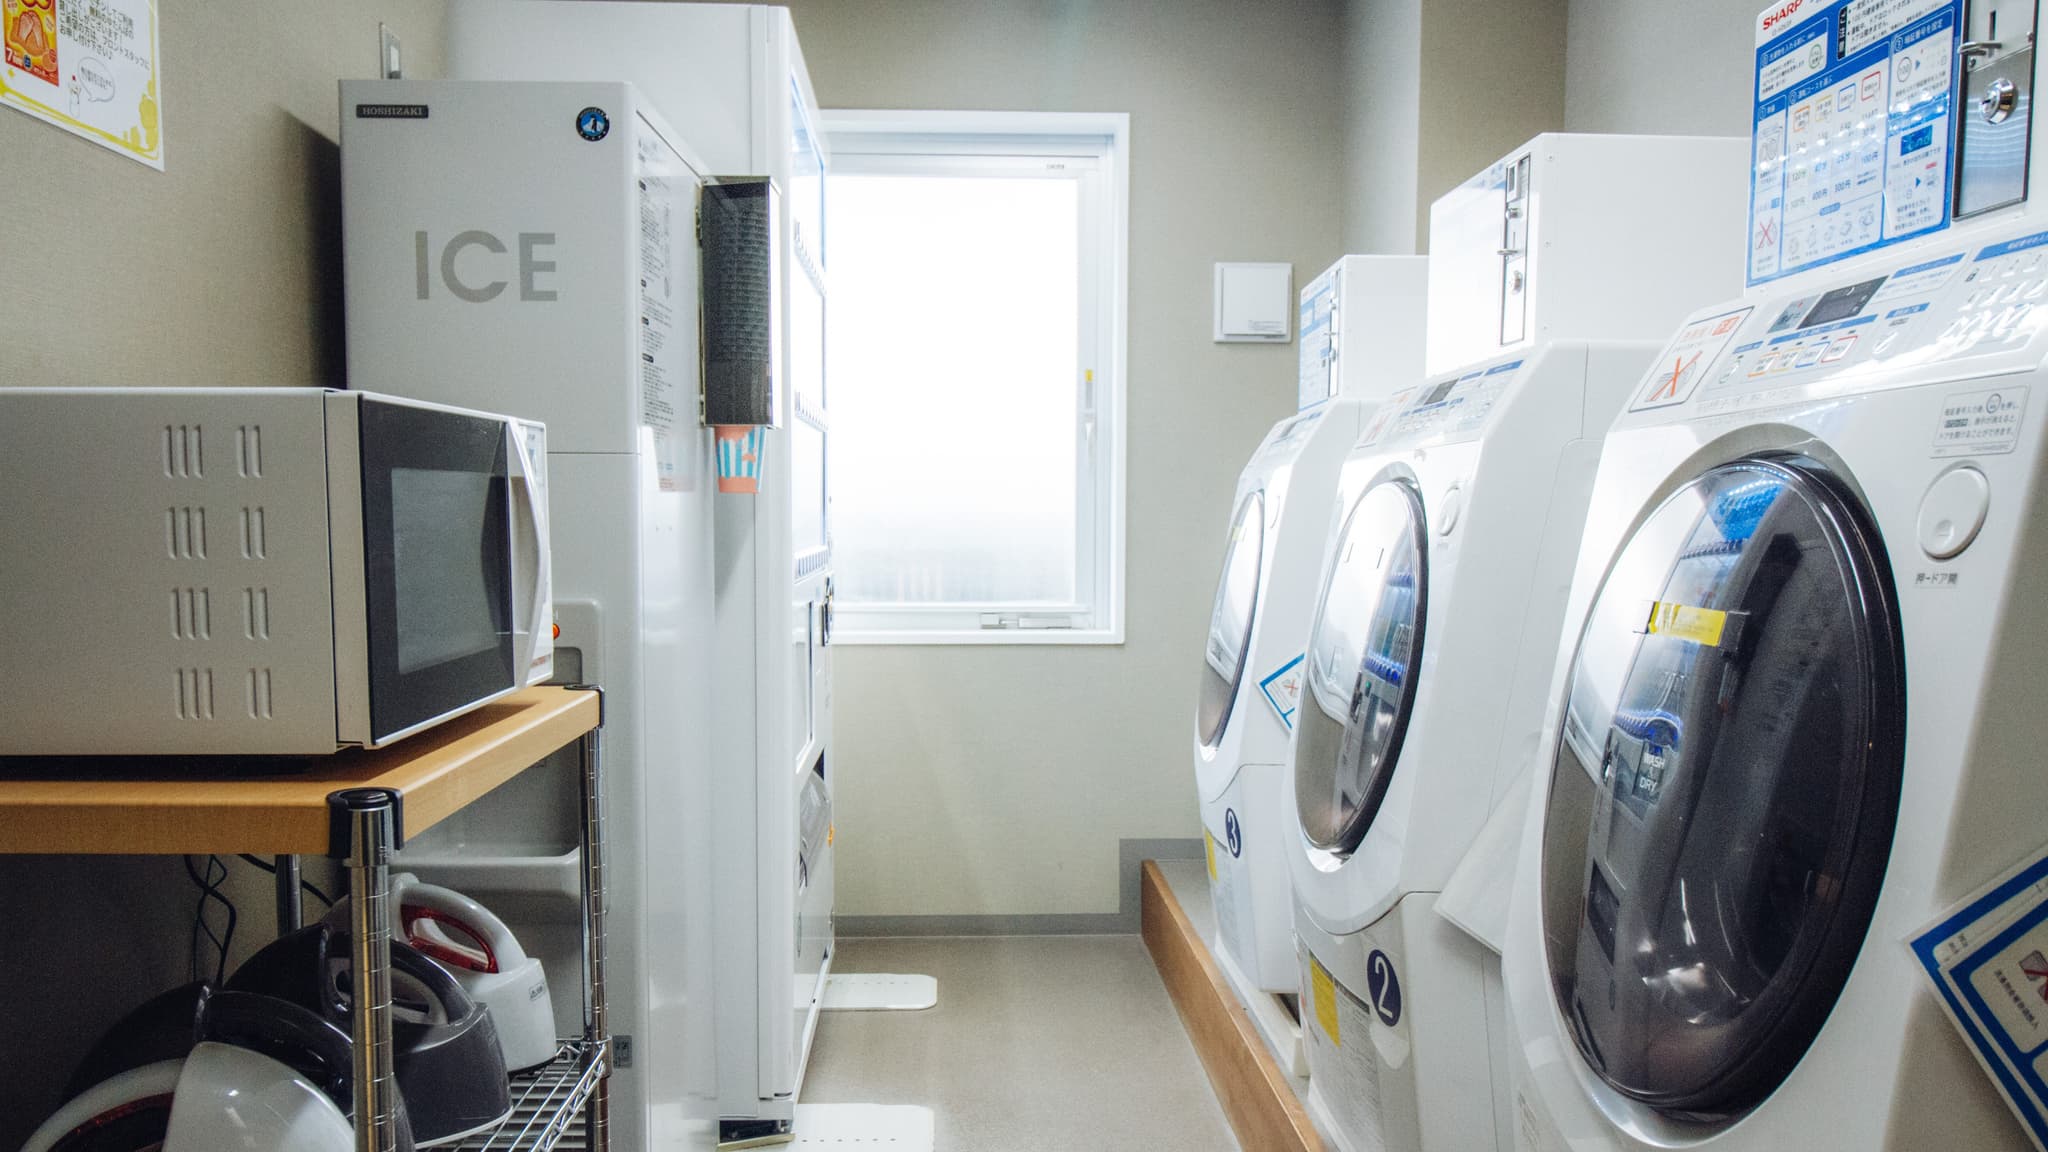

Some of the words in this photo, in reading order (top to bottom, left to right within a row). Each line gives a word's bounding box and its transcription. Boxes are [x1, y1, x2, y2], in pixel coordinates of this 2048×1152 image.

[1762, 0, 1802, 31] SHARP
[362, 107, 423, 117] HOSHIZAKI
[415, 230, 558, 303] ICE
[1375, 955, 1393, 1018] 2
